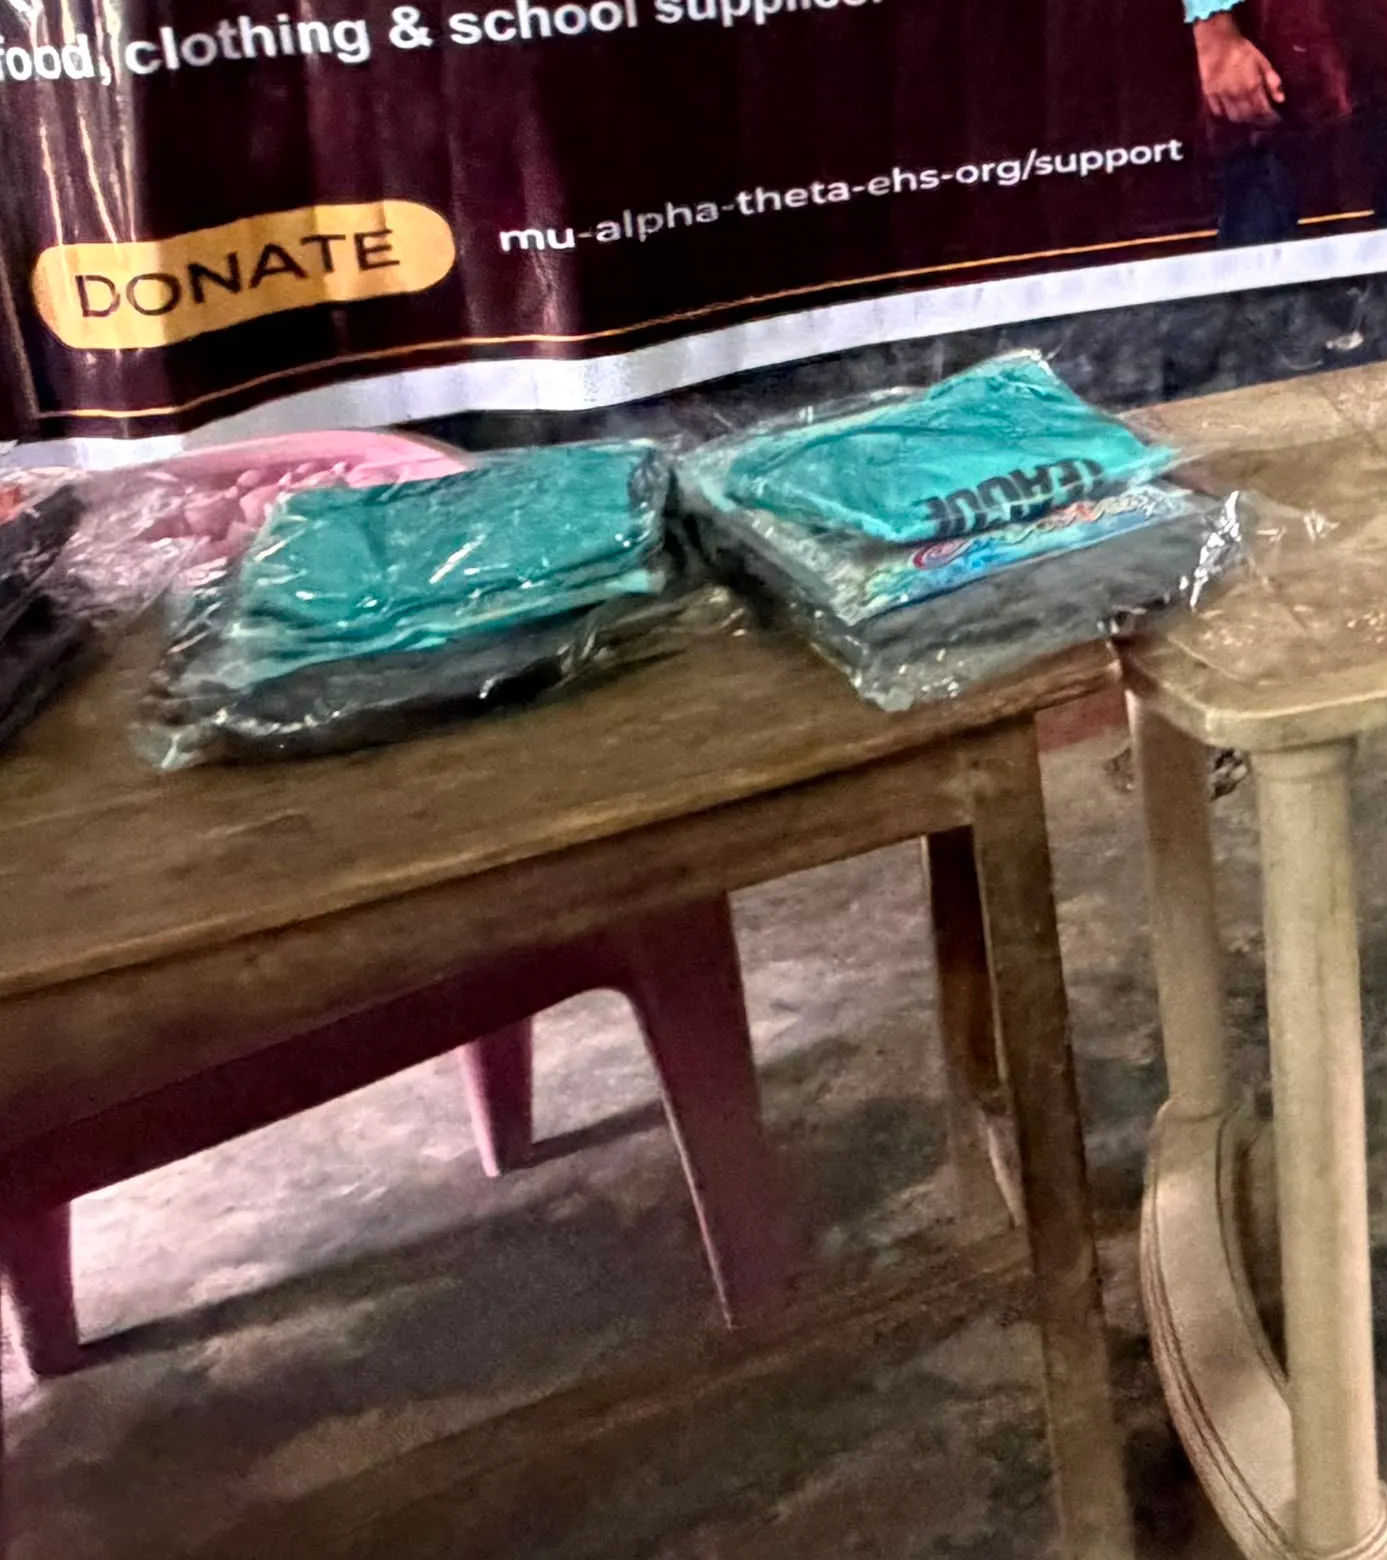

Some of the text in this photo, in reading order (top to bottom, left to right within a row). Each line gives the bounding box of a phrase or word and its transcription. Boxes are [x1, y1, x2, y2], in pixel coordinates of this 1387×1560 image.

[124, 14, 369, 76] clothing
[388, 4, 434, 50] &
[499, 138, 1184, 253] mu-alpha-theta-ehs-org/support
[74, 228, 401, 319] DONATE
